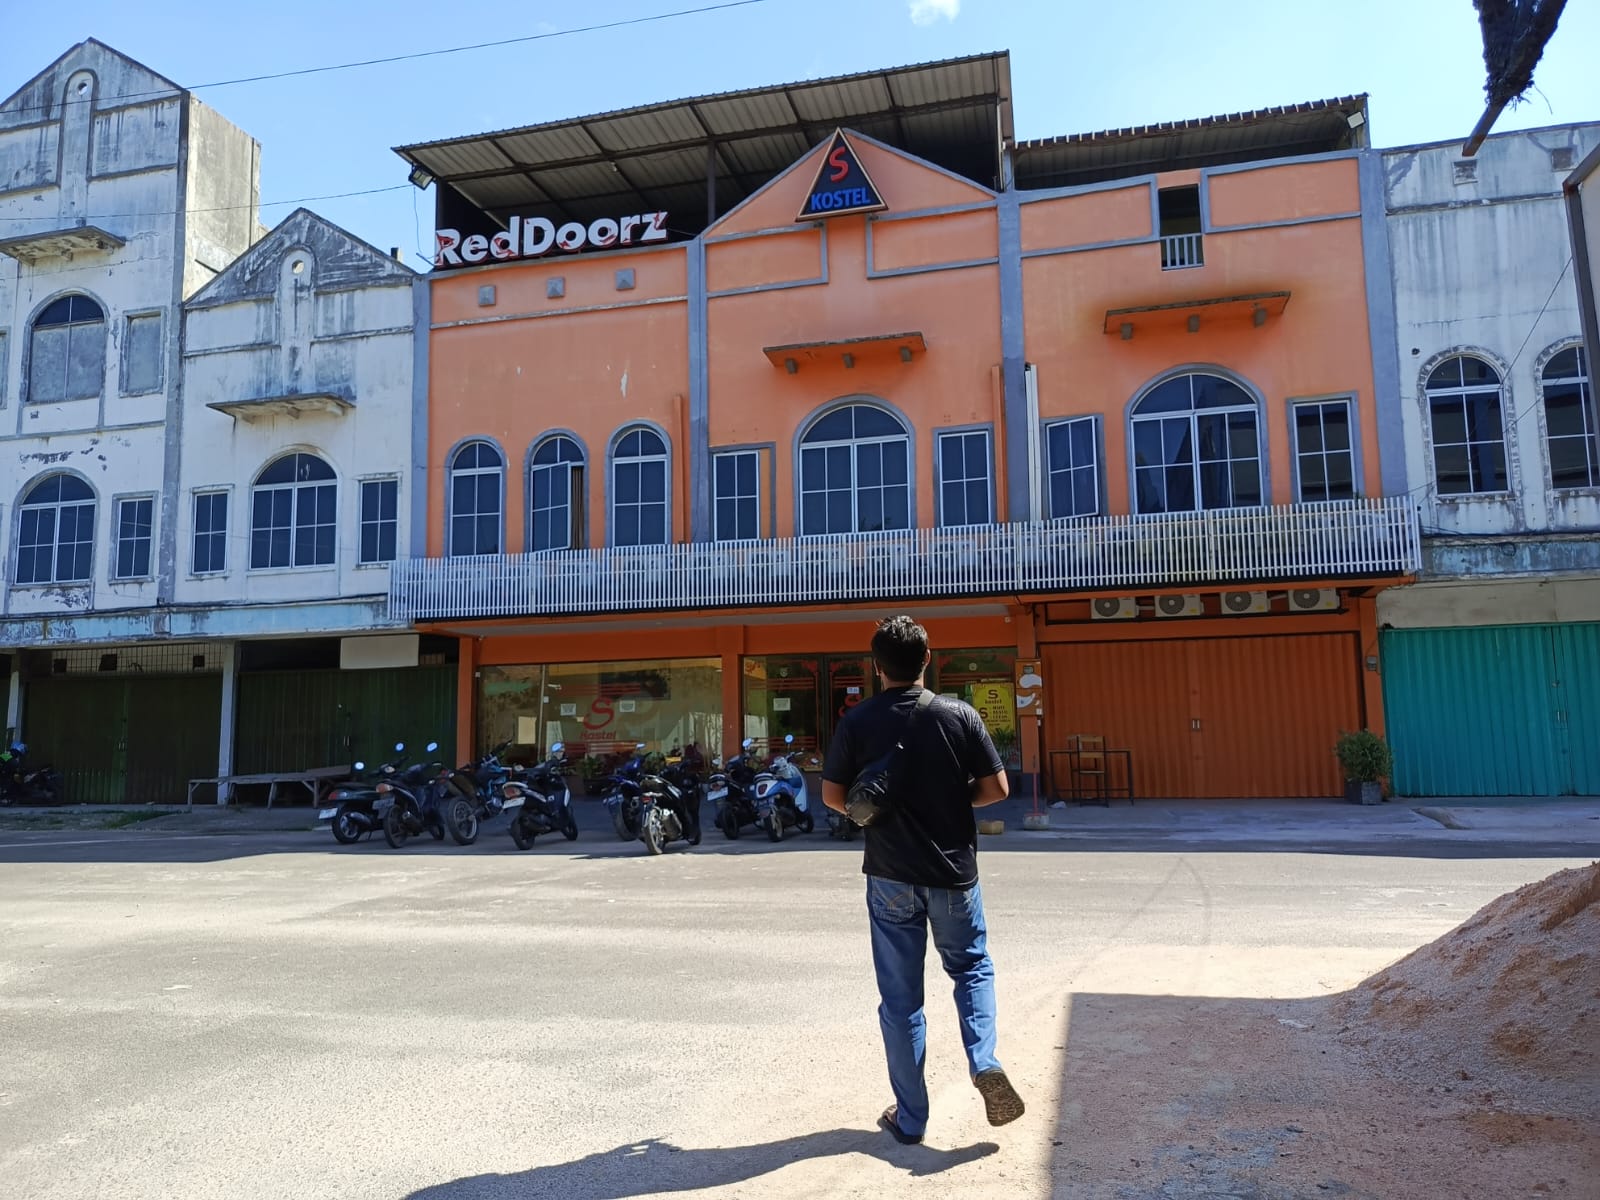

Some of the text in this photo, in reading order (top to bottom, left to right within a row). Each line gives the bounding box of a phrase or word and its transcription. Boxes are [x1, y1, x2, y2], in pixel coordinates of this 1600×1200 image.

[829, 146, 848, 182] S
[811, 187, 871, 210] KOSTEL
[435, 211, 668, 267] RedDoorz
